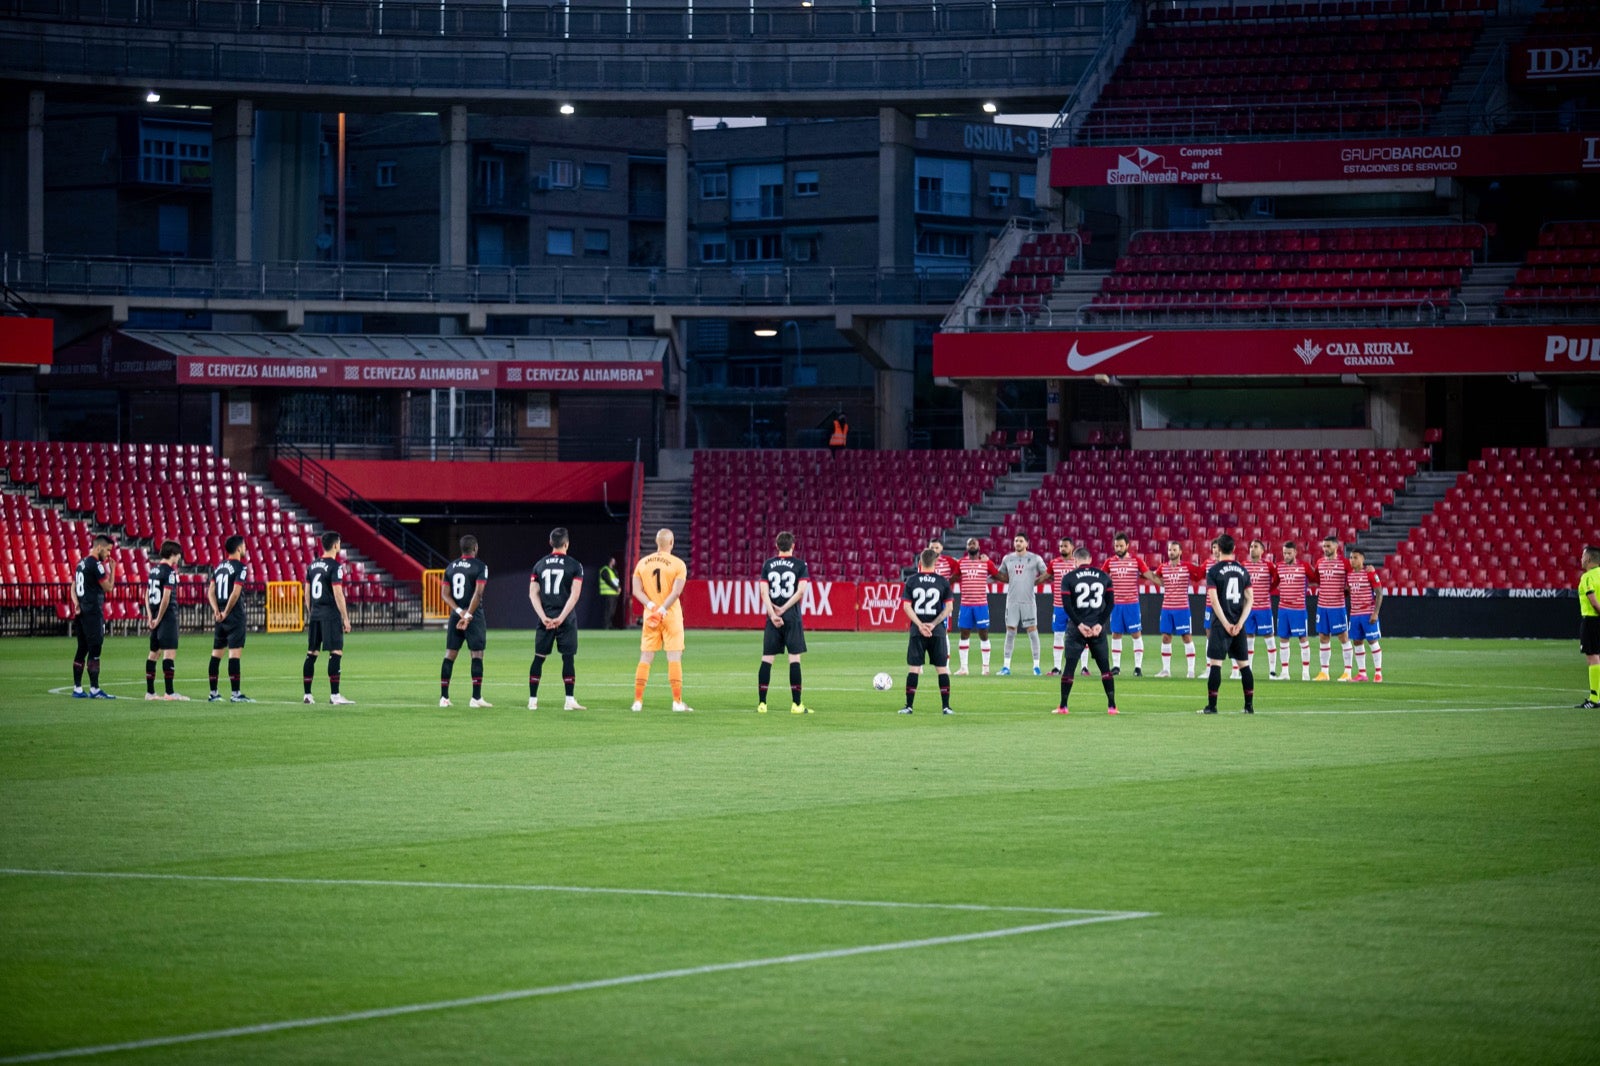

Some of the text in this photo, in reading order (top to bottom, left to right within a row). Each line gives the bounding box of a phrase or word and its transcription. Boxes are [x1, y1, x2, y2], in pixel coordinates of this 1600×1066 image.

[1180, 147, 1222, 157] Compost
[1191, 160, 1210, 169] and
[1343, 162, 1457, 173] ESTACIONES DE SERVICIO
[1181, 171, 1209, 182] Paper
[1326, 341, 1413, 356] CAJA RURAL
[1344, 355, 1395, 366] GRANADA
[207, 363, 258, 378] CERVEZAS
[261, 364, 318, 379] ALHAMBRA
[363, 366, 416, 380] CERVEZAS
[420, 367, 479, 380] ALHAMBRA
[526, 368, 580, 381] CERVEZAS
[582, 368, 644, 382] ALHAMBRA
[215, 573, 229, 600] 11
[311, 573, 323, 599] 6
[452, 573, 466, 600] 8
[541, 569, 565, 595] 17
[652, 568, 662, 593] 1
[767, 571, 796, 598] 33
[1226, 577, 1242, 604] 4
[912, 587, 940, 615] 22
[1075, 582, 1105, 609] 23
